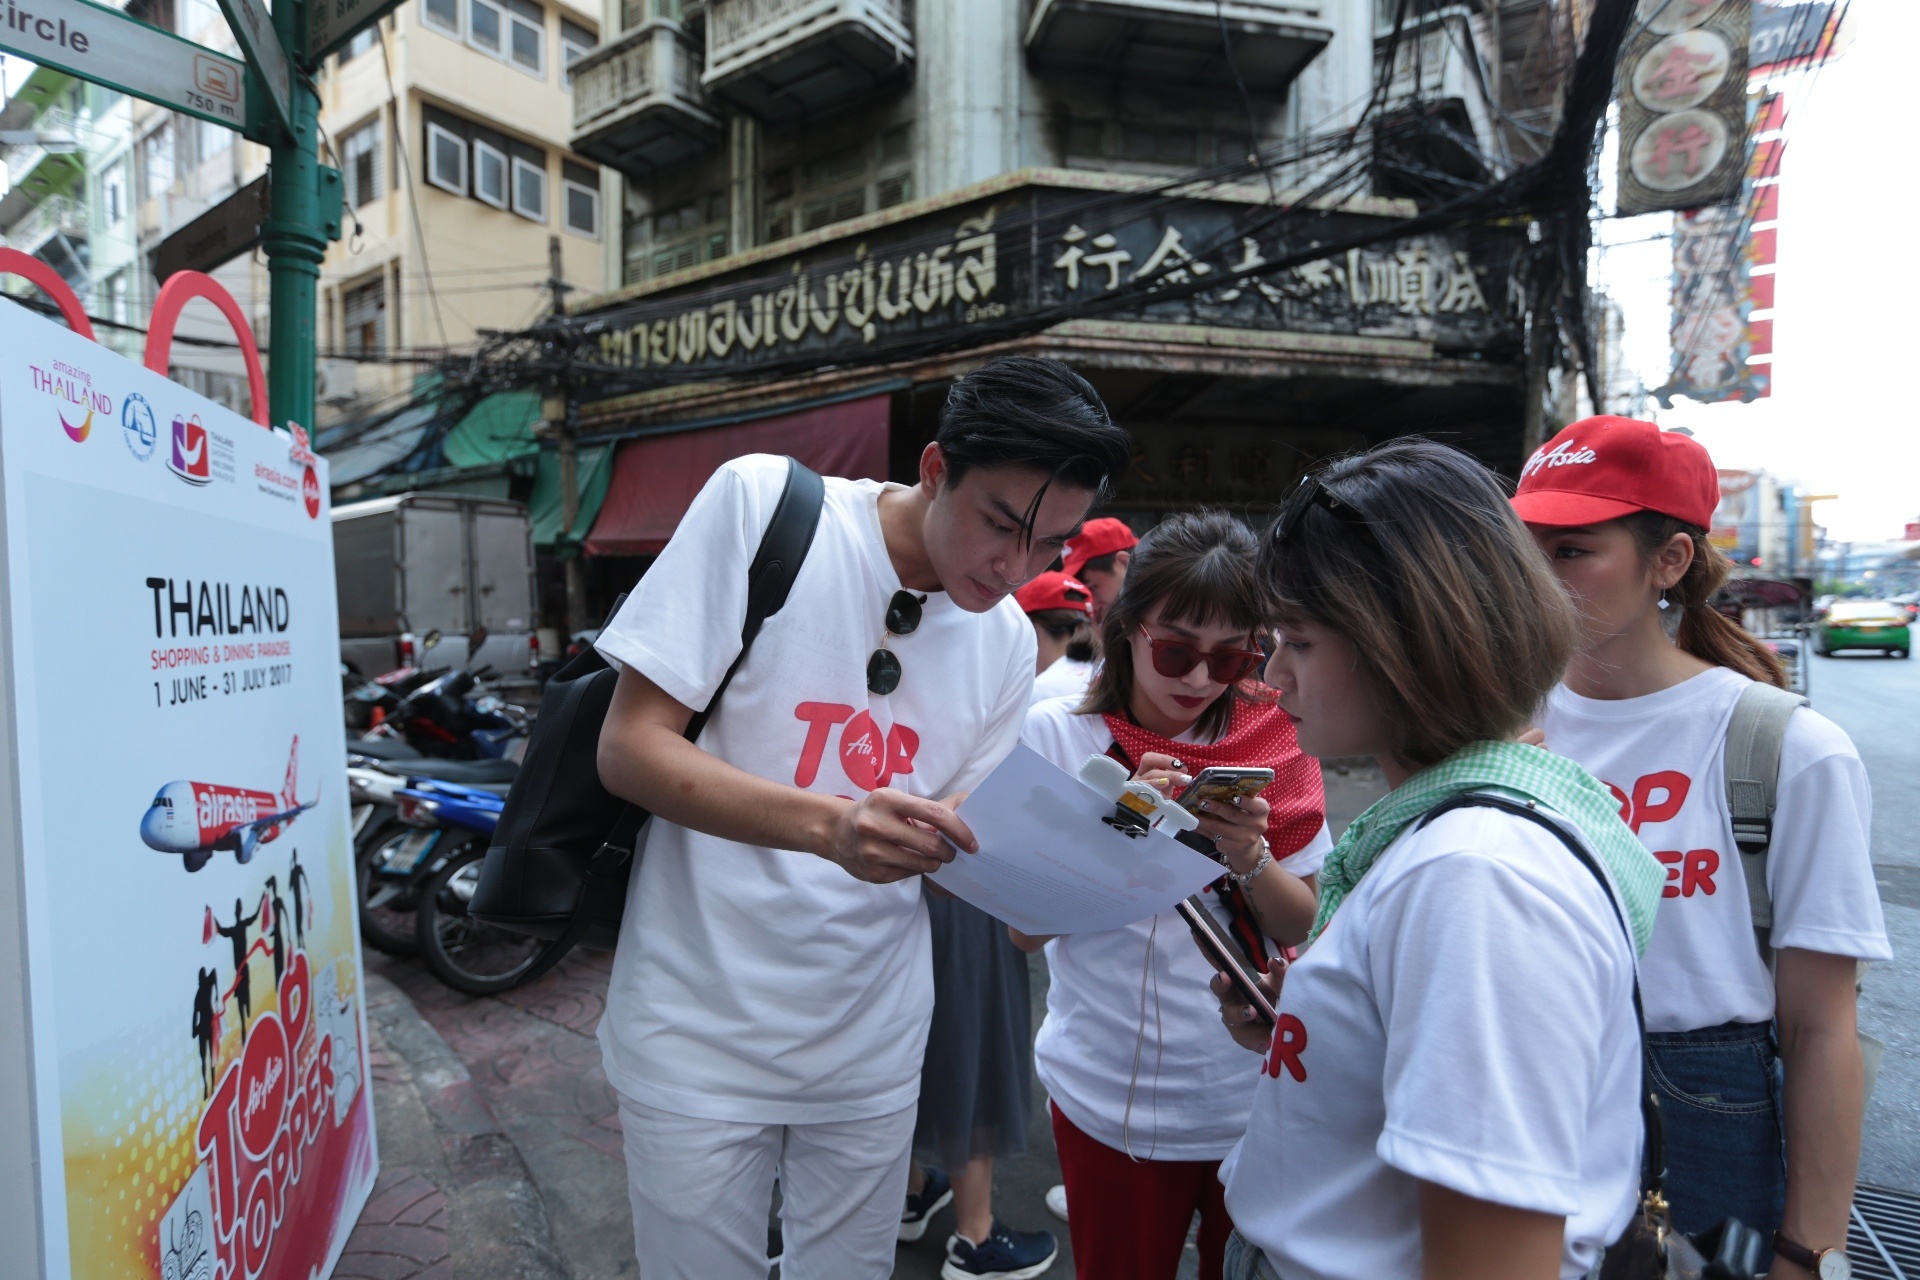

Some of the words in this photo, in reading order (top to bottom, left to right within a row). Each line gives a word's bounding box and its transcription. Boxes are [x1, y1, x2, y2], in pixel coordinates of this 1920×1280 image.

[0, 0, 90, 53] ircle
[185, 90, 214, 112] 750
[29, 365, 113, 416] THAILAND
[52, 359, 92, 387] amazing
[146, 577, 289, 639] THAILAND
[151, 646, 209, 670] SHOPPING
[213, 646, 220, 663] &
[224, 643, 255, 661] DINING
[257, 641, 291, 658] PARADISE
[154, 681, 161, 707] 1
[170, 675, 207, 706] JUNE
[223, 672, 237, 695] 31
[242, 666, 266, 691] JULY
[270, 664, 292, 685] 2017
[200, 786, 257, 829] airasia
[244, 1056, 284, 1132] AirAsia
